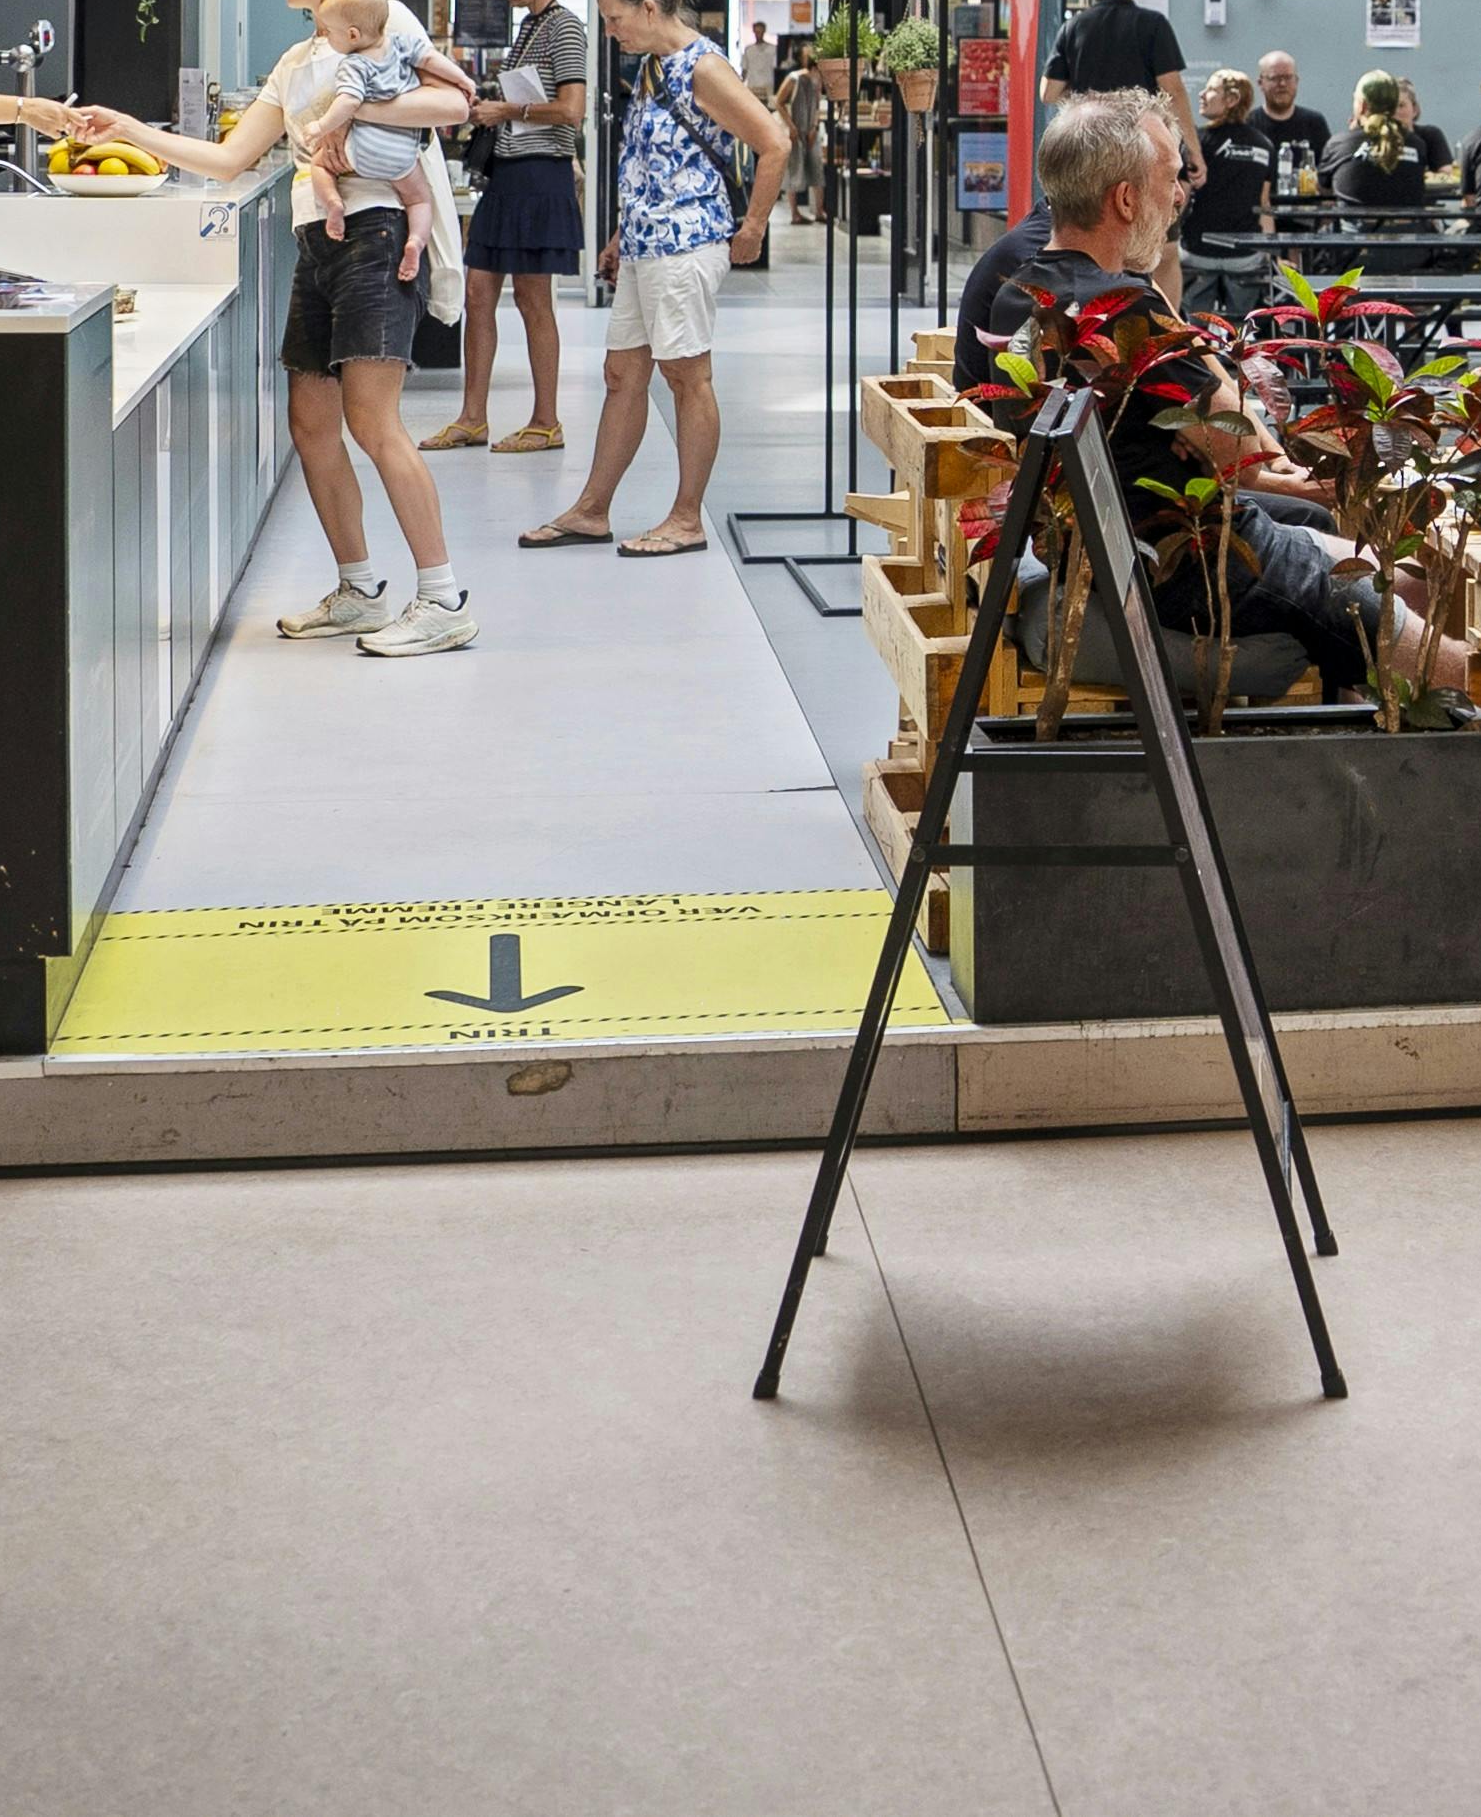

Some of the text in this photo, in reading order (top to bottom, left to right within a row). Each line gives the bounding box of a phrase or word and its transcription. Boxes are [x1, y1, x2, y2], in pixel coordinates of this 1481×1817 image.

[321, 898, 681, 916] LÆNGERE FREMME
[238, 905, 762, 929] VÆR OPMÆRKSOM PÅ TRIN
[449, 1026, 560, 1039] TRIN
